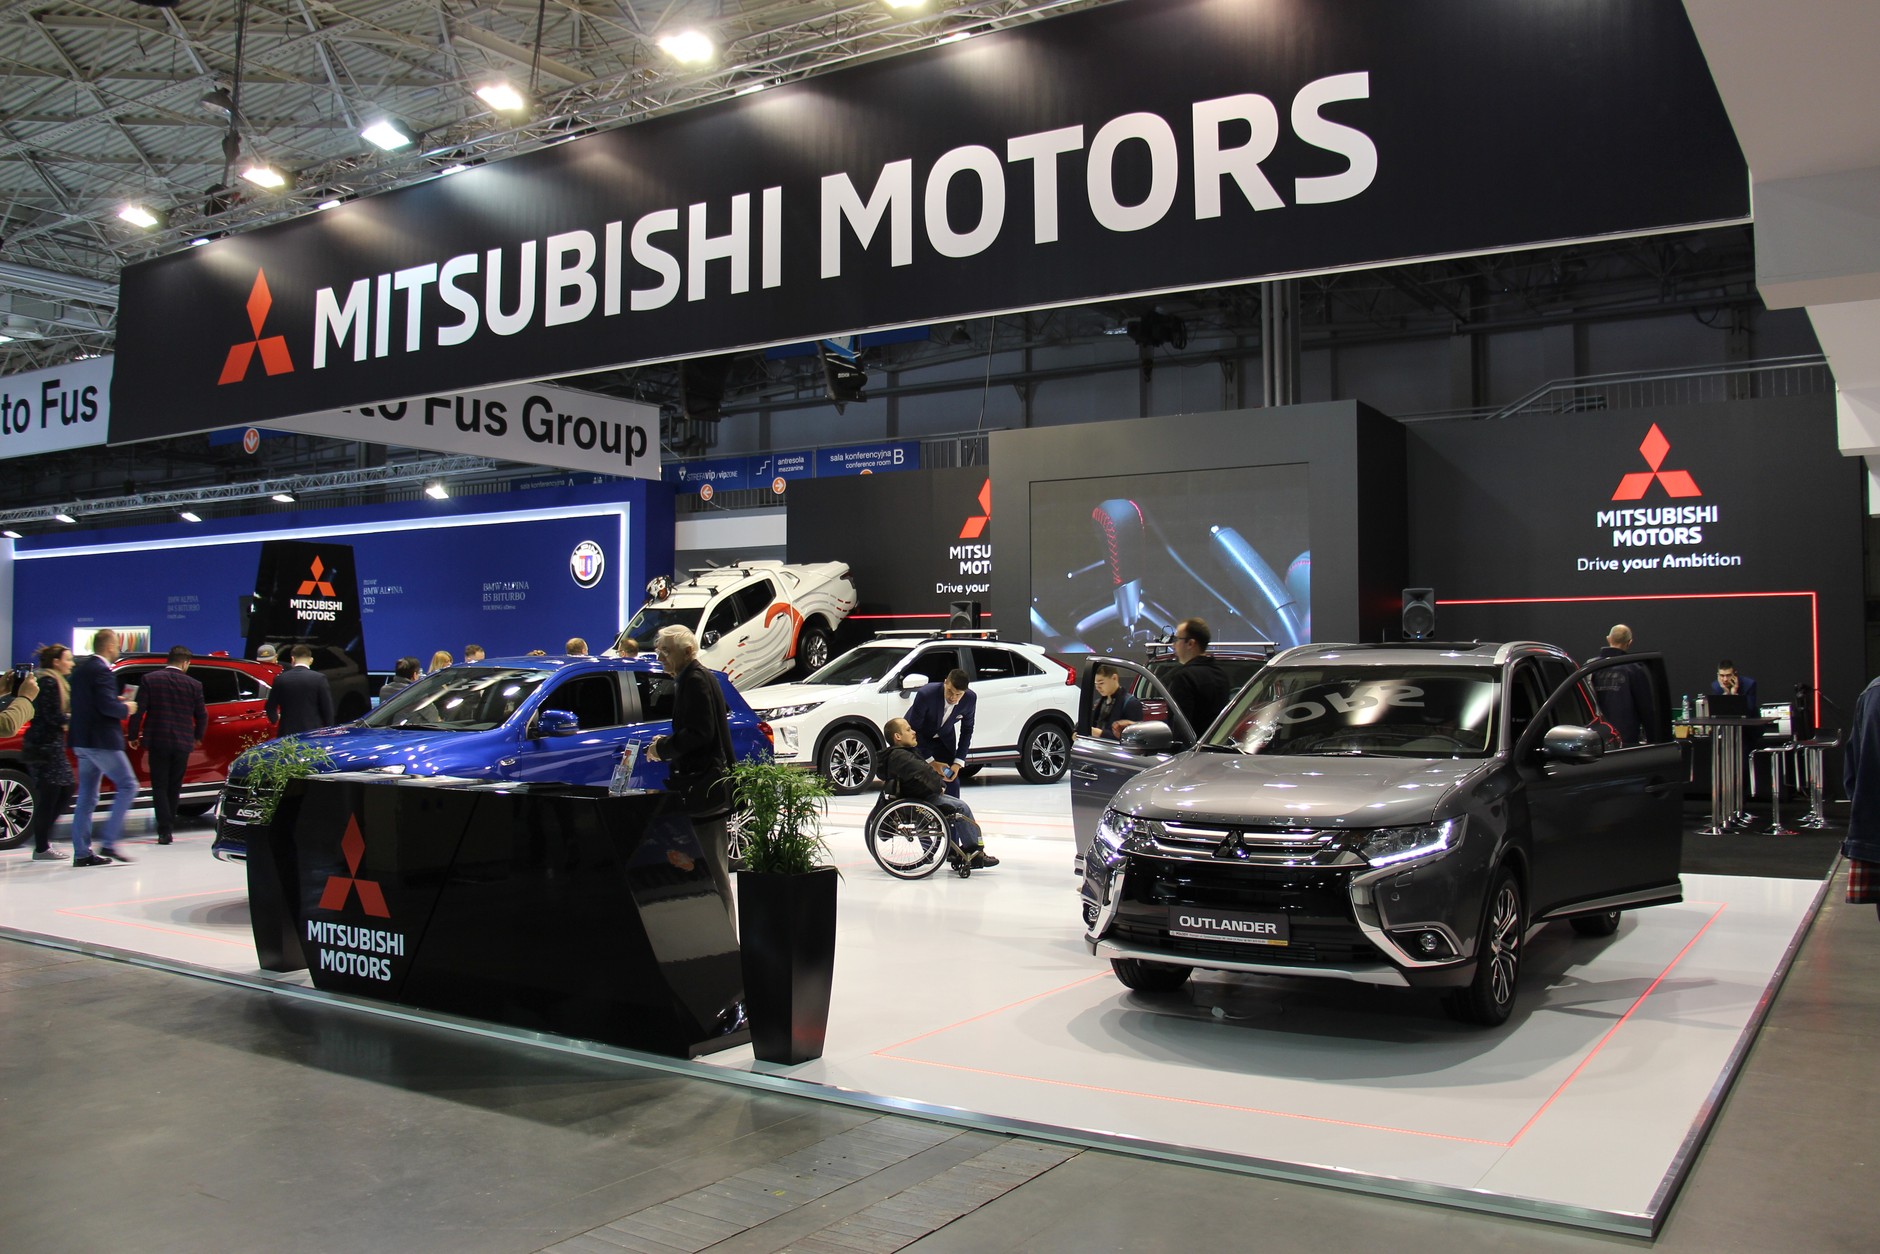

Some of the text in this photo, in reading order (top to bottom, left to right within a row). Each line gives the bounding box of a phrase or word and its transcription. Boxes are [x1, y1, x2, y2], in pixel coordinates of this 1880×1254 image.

[313, 71, 1378, 369] MITSUBISHI MOTORS
[41, 378, 99, 427] Fus
[521, 395, 648, 466] Group
[777, 456, 805, 466] antresola
[830, 448, 905, 465] sala konferencyjna B
[845, 461, 876, 469] conference
[778, 465, 804, 473] mezzanine
[1596, 505, 1719, 528] MITSUBISHI
[1612, 526, 1704, 548] MOTORS
[1577, 551, 1742, 574] Drive your Ambition
[936, 582, 990, 596] Drive your
[290, 599, 343, 611] MITSUBISHI
[297, 610, 336, 621] MOTORS
[1179, 915, 1277, 934] OUTLANDER
[307, 920, 404, 956] MITSUBISHI
[320, 948, 391, 981] MOTORS
